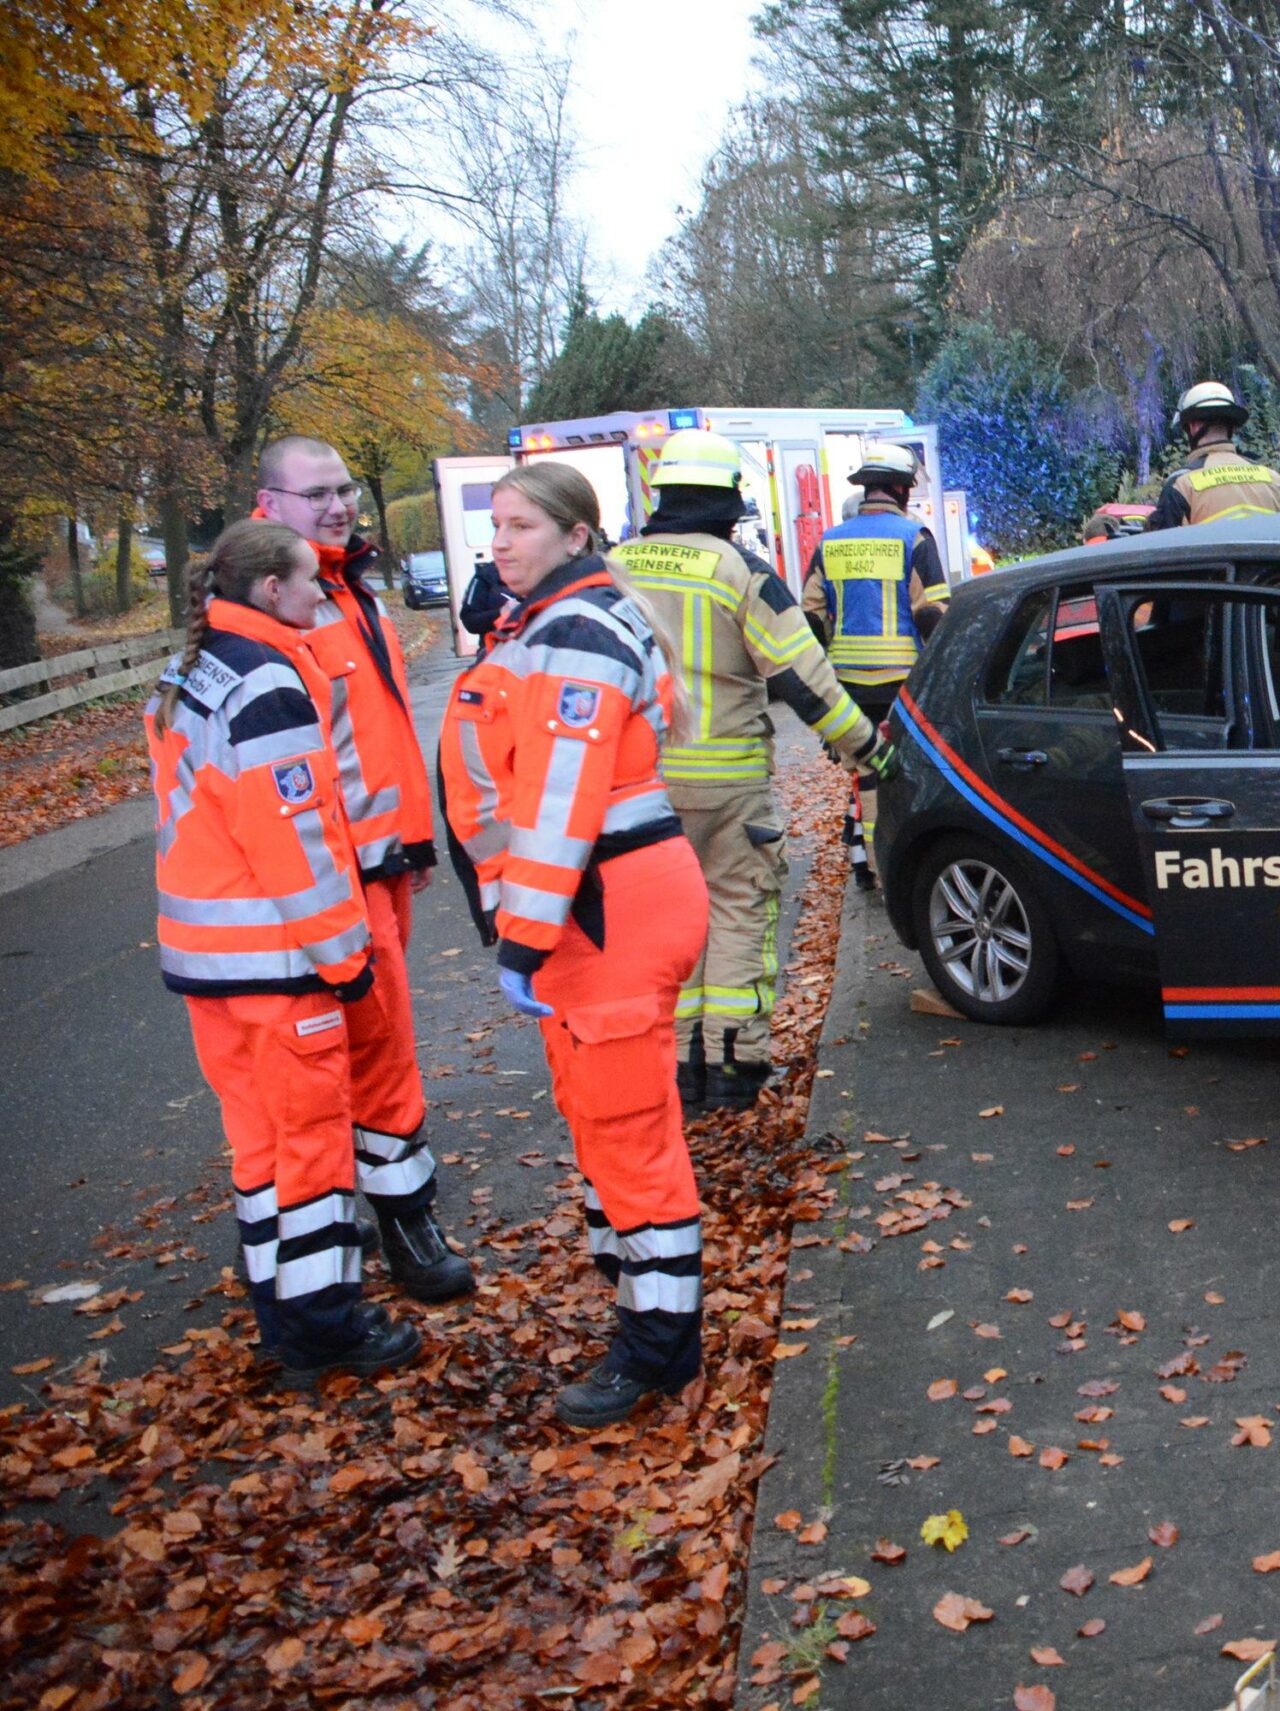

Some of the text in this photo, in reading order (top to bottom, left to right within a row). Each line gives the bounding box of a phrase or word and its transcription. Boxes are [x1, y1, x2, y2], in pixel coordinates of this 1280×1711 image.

[1202, 466, 1260, 477] FEUERWEHR
[621, 544, 701, 560] FEUERWEHR
[626, 559, 684, 572] REINBEK
